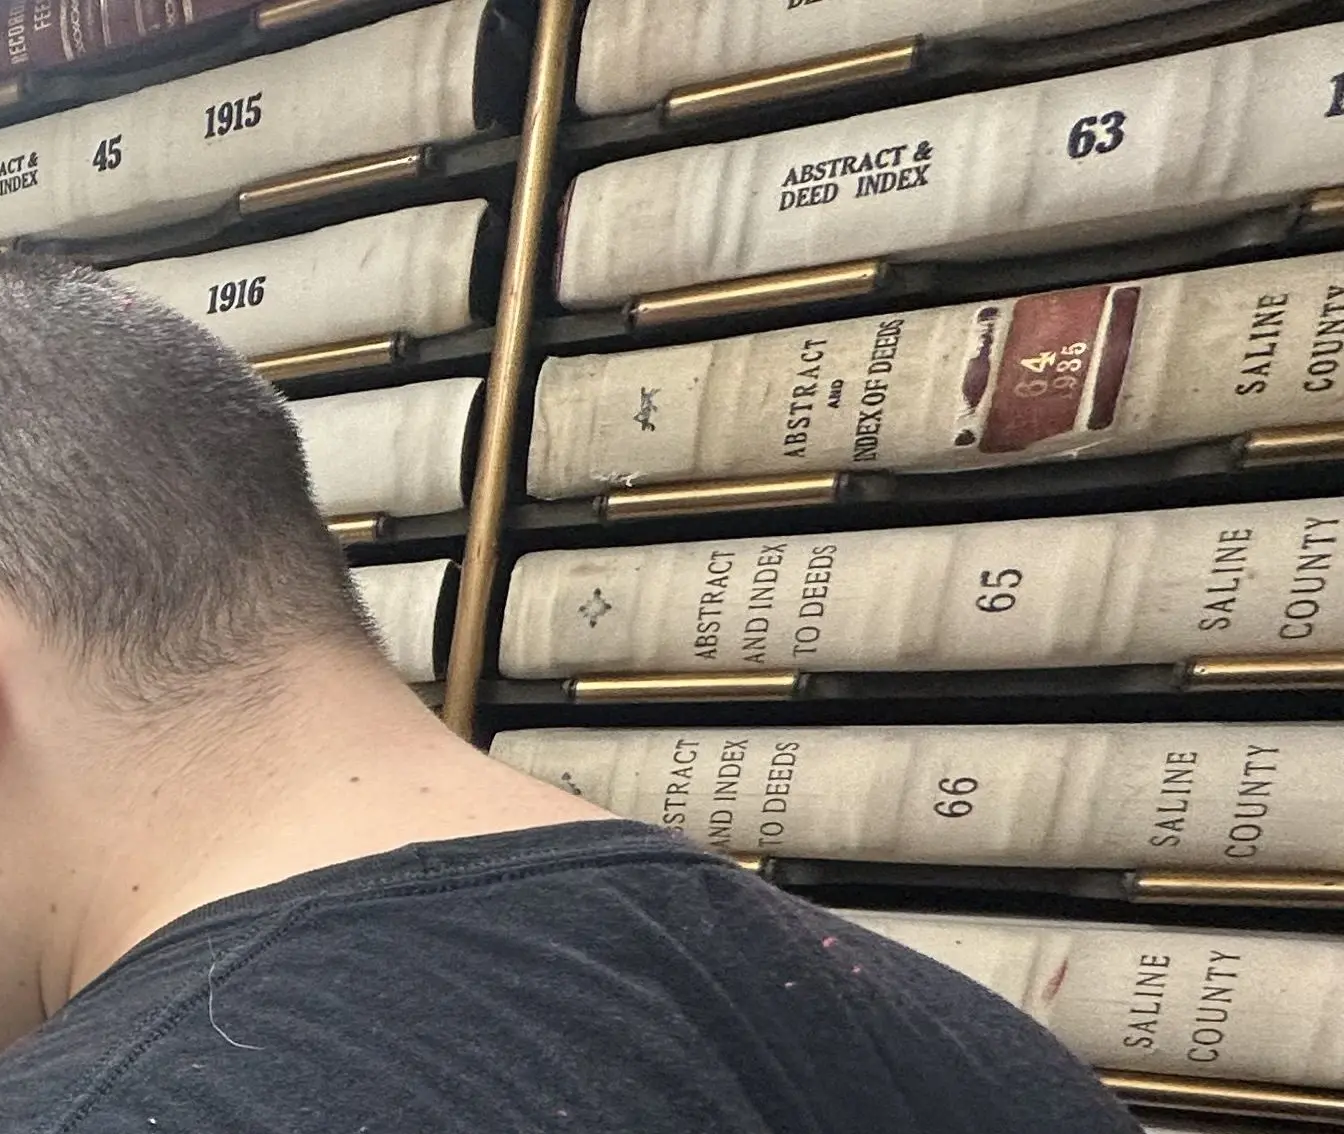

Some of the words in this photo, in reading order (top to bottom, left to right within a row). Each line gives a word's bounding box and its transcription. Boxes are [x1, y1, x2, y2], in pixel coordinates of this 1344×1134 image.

[204, 92, 262, 139] 1915
[1067, 110, 1127, 160] 63
[27, 152, 38, 168] &
[92, 135, 122, 173] 45
[782, 145, 908, 188] ABSTRACT
[913, 140, 934, 163] &
[0, 170, 38, 194] INDEX
[779, 183, 839, 211] DEED
[855, 164, 930, 197] INDEX
[207, 276, 265, 315] 1916
[868, 319, 905, 374] DEEDS
[1235, 293, 1289, 395] SALINE
[784, 340, 828, 457] ABSTRACT
[828, 379, 844, 408] AND
[861, 379, 888, 407] OF
[1014, 351, 1056, 398] 64
[853, 408, 883, 462] INDEX
[749, 542, 788, 619] INDEX
[802, 542, 839, 619] DEEDS
[975, 567, 1024, 614] 65
[1198, 526, 1254, 632] SALINE
[1279, 514, 1341, 641] COUNTY
[693, 548, 738, 661] ABSTRACT
[743, 621, 771, 665] AND
[793, 622, 821, 658] TO
[714, 739, 748, 801] INDEX
[762, 742, 800, 813] DEEDS
[934, 774, 980, 819] 66
[1151, 748, 1198, 848] SALINE
[1225, 742, 1280, 860] COUNTY
[708, 809, 733, 850] AND
[759, 821, 784, 848] TO
[1123, 950, 1172, 1049] SALINE
[1188, 947, 1243, 1064] COUNTY
